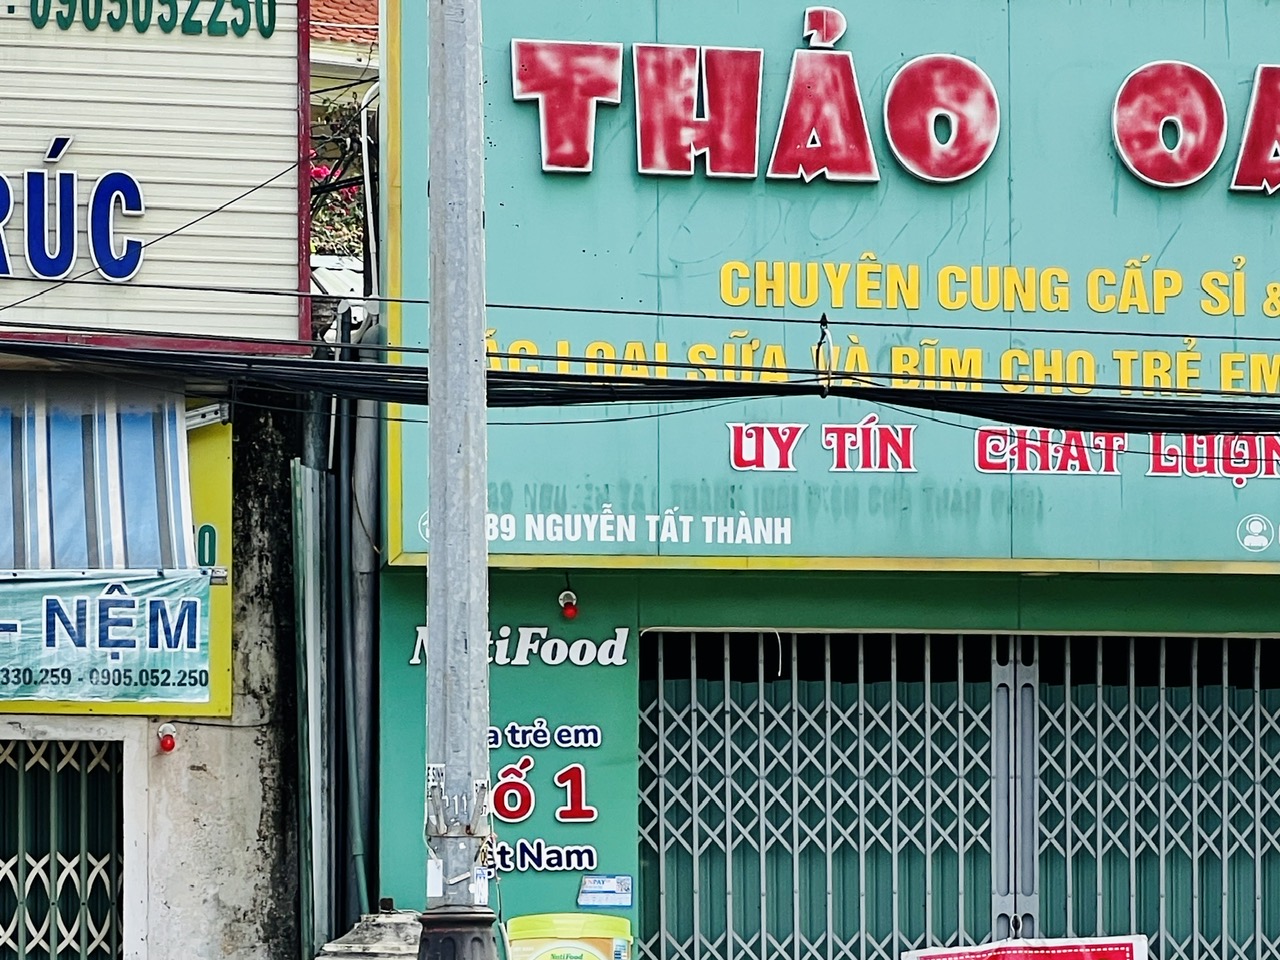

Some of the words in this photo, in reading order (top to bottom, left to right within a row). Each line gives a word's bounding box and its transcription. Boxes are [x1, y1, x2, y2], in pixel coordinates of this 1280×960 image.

[510, 6, 1001, 184] THẢO
[0, 136, 146, 281] ÚC
[719, 251, 920, 310] CHUYÊN
[937, 264, 1070, 313] CUNG
[1086, 255, 1183, 314] CẤP
[1200, 255, 1246, 317] SỈ
[686, 330, 789, 384] SỮA
[811, 334, 872, 388] VÀ
[1000, 348, 1096, 395] CHO
[1112, 337, 1202, 396] TRẺ
[726, 422, 809, 471] UY
[821, 412, 918, 472] TÍN
[525, 503, 636, 542] NGUYỄN
[645, 506, 694, 543] TẤT
[701, 511, 792, 545] THÀNH
[44, 583, 199, 661] NỆM
[89, 667, 209, 687] 0905.052.250
[506, 719, 550, 746] trẻ
[555, 726, 601, 747] em
[555, 764, 598, 822] 1
[517, 840, 597, 872] Nam
